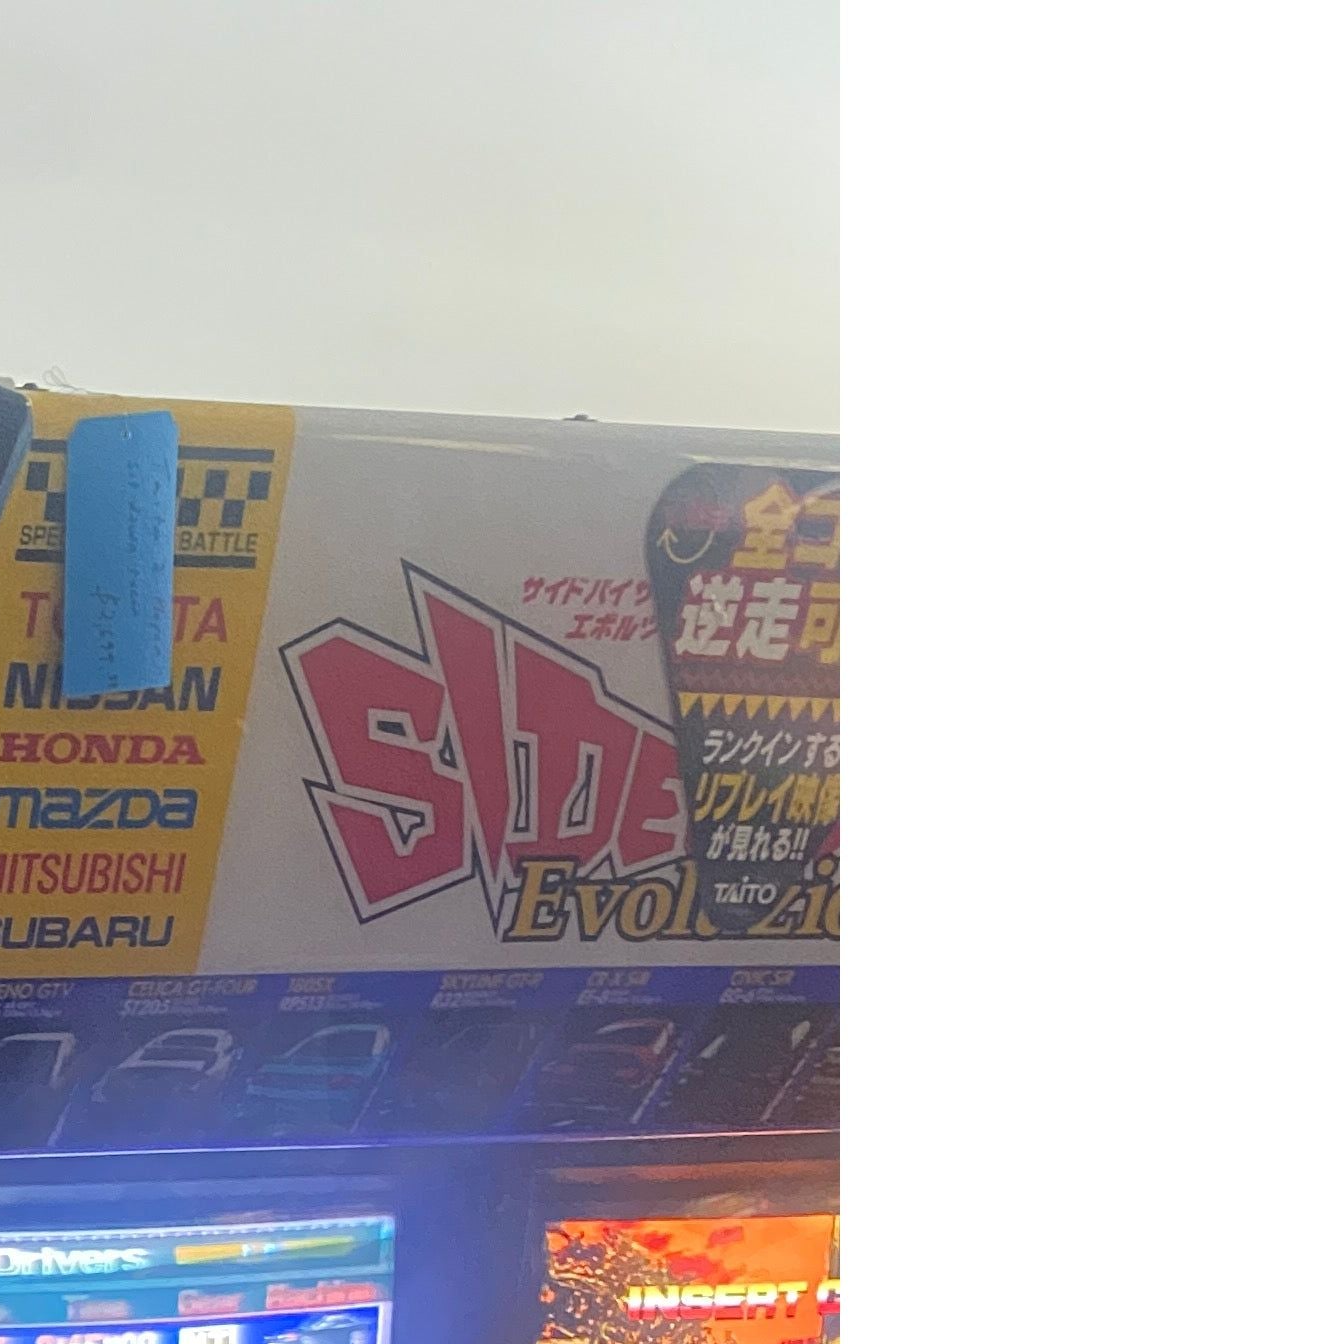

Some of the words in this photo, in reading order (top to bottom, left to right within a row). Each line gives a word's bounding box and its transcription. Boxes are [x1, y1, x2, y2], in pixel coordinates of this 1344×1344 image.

[179, 530, 259, 554] BATTLE
[21, 590, 229, 644] TTA
[625, 1280, 808, 1321] INSERT
